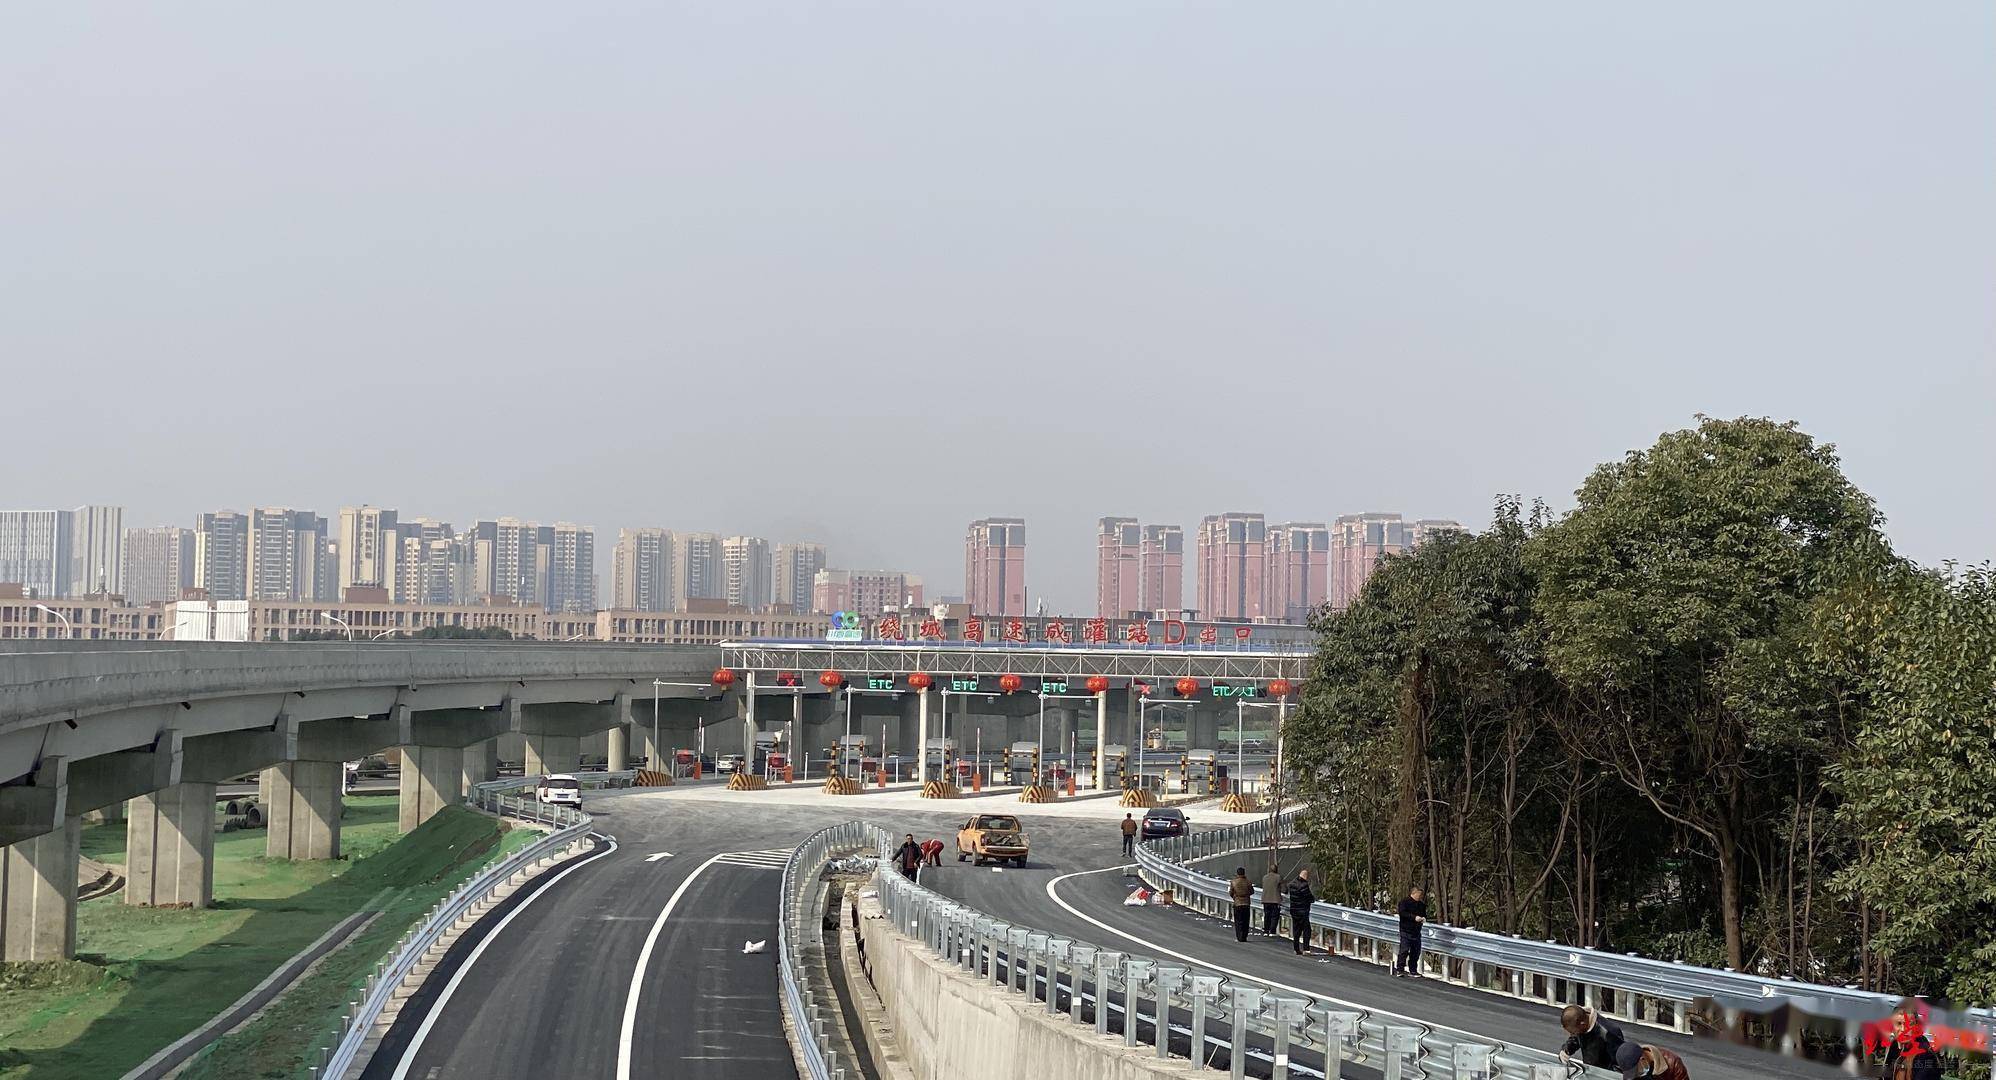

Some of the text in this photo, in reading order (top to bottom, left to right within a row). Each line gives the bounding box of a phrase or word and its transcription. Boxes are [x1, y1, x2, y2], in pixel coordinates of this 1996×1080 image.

[869, 680, 893, 690] ETC
[953, 680, 978, 691] ETC
[1042, 683, 1067, 693] ETC
